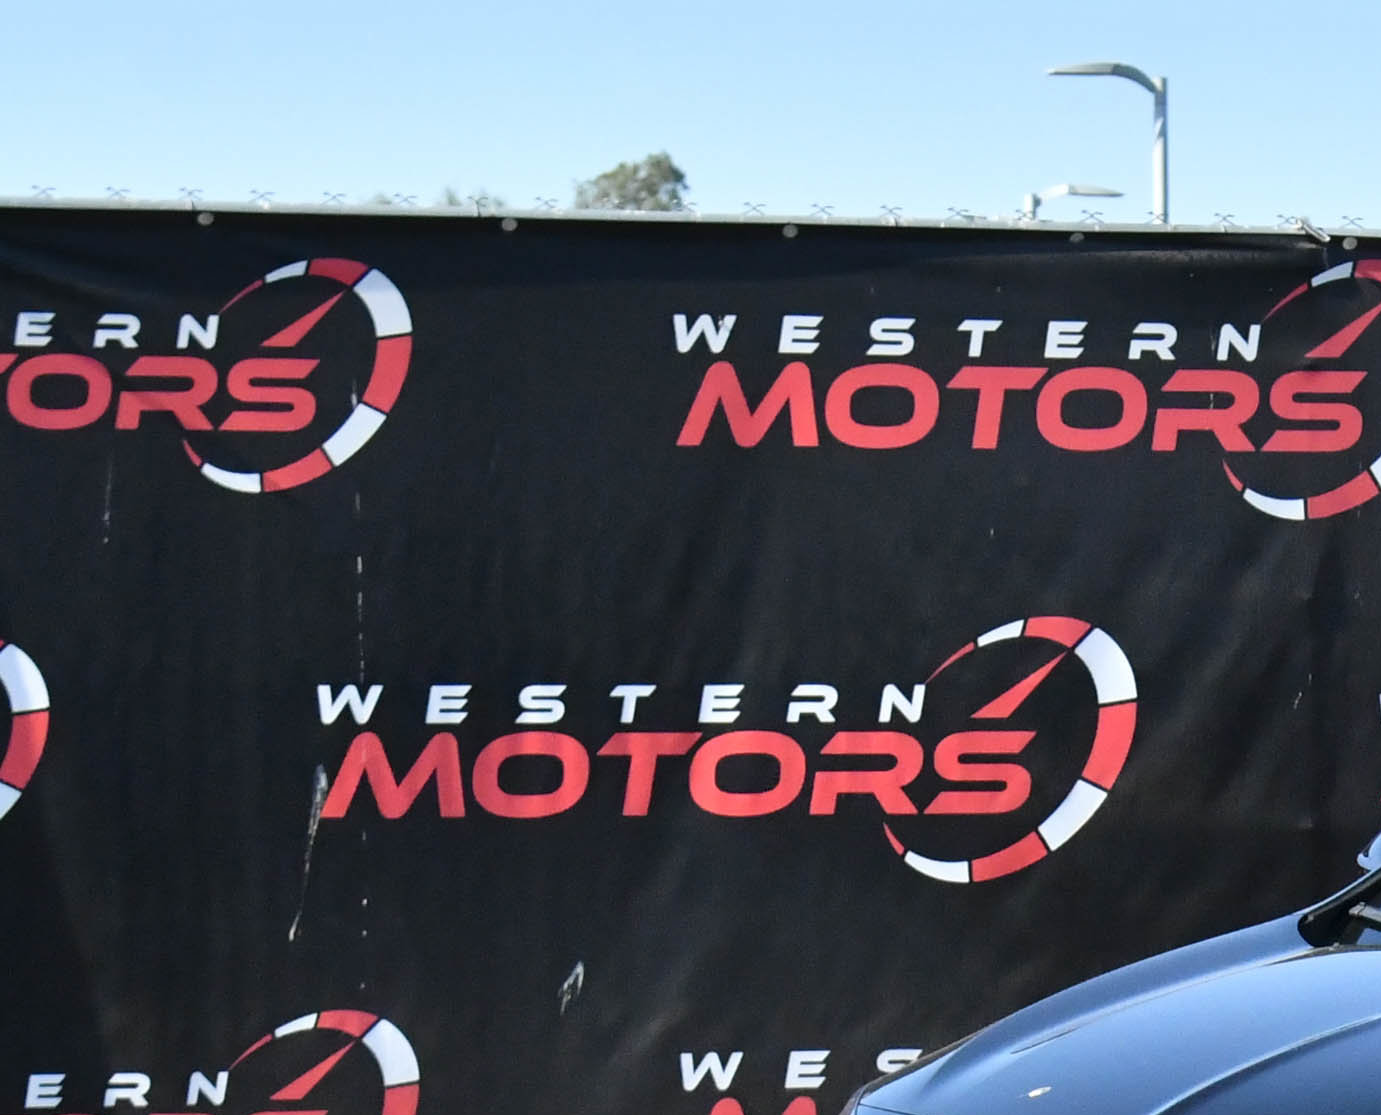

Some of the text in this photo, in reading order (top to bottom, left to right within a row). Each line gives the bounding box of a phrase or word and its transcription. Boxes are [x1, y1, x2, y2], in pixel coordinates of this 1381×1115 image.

[673, 313, 1261, 362] WESTERN
[676, 361, 1367, 453] MOTORS
[317, 683, 926, 725] WESTERN
[319, 729, 1037, 820] MOTORS
